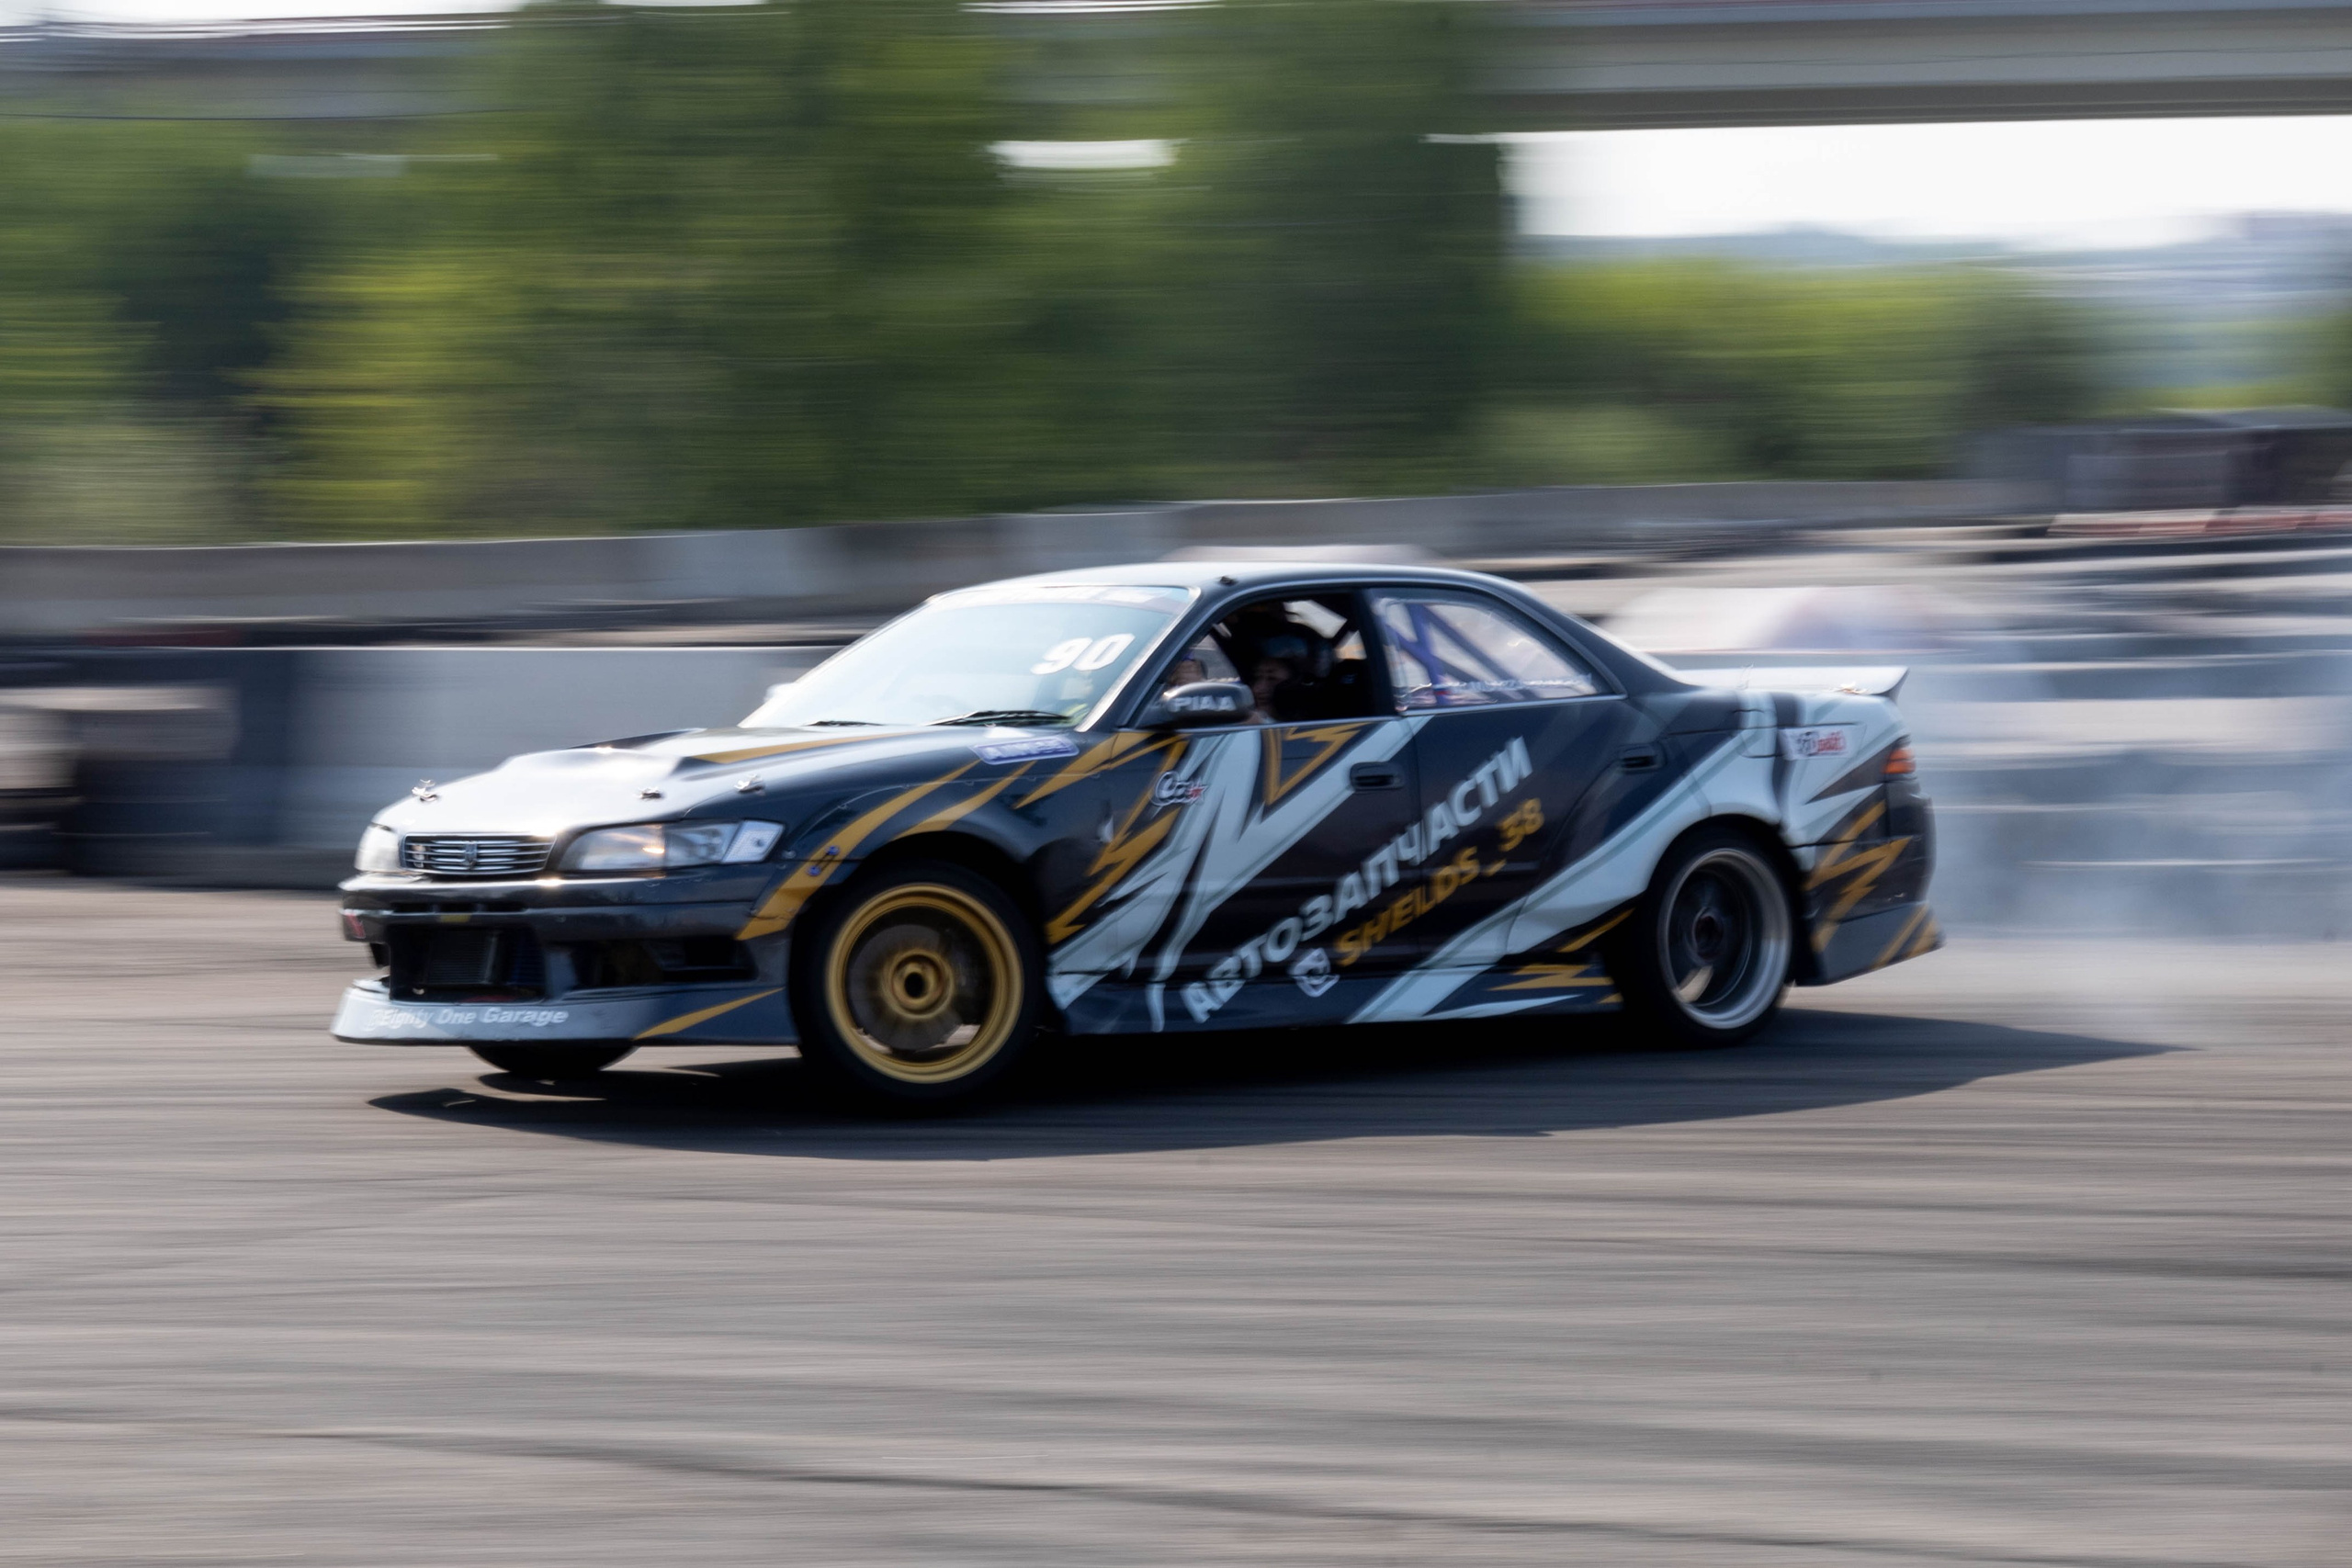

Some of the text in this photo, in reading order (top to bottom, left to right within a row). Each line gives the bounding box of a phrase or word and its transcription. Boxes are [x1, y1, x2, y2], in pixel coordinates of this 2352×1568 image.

[1030, 633, 1136, 675] 90
[1169, 695, 1237, 712] PIAA
[1179, 736, 1533, 1023] АВТОЗАПЧАСТИ
[435, 1009, 477, 1024] One
[481, 1007, 570, 1027] Garage
